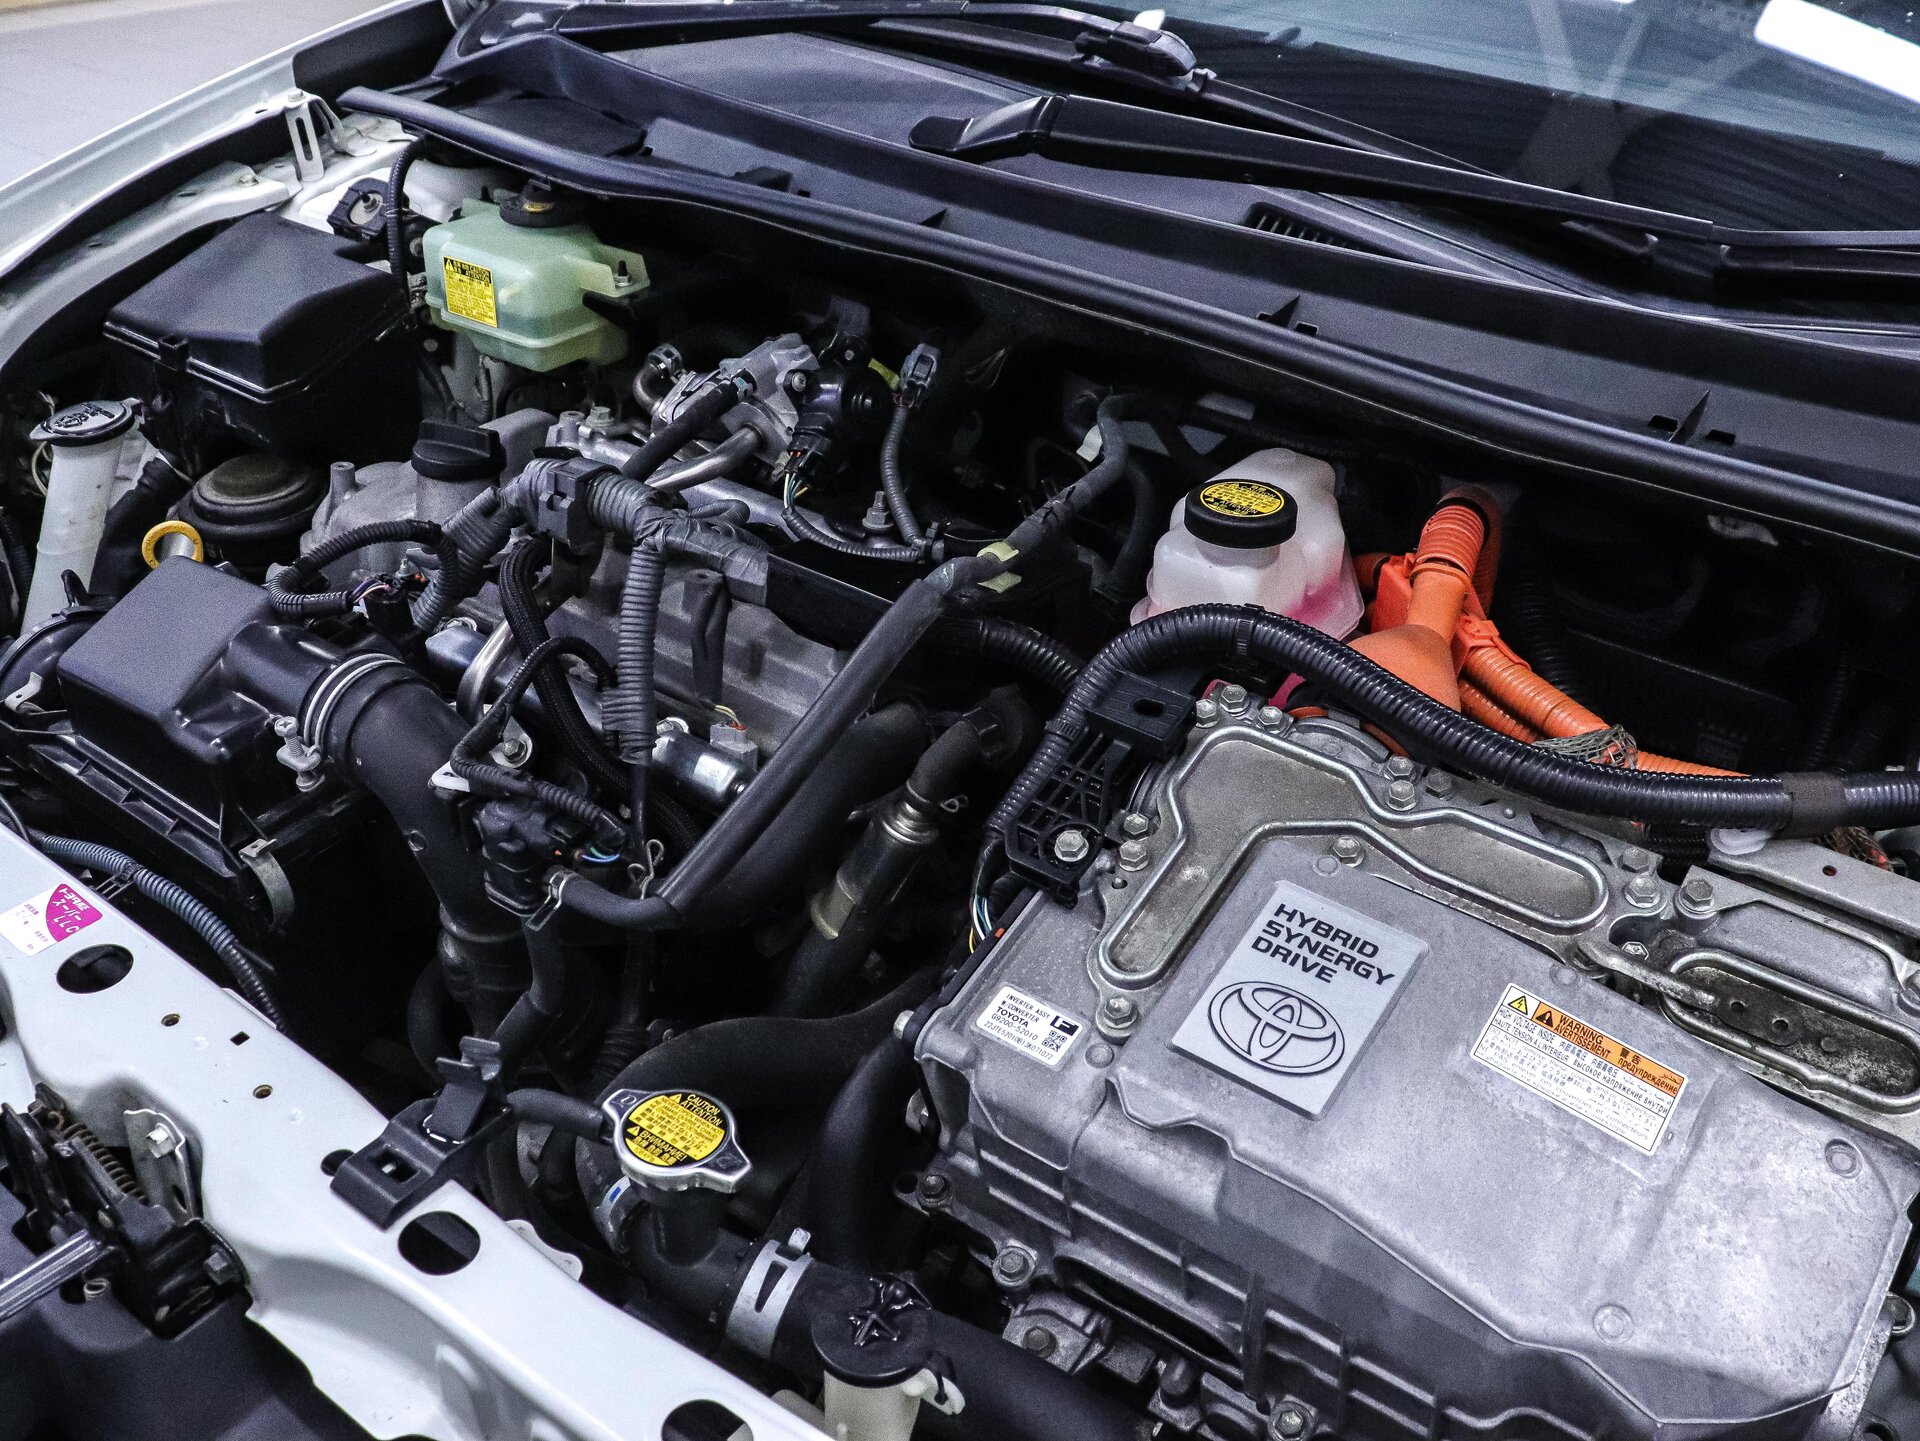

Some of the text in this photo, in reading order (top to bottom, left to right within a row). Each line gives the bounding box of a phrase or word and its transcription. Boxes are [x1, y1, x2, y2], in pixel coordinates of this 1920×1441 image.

[53, 915, 80, 933] LLC
[1274, 903, 1379, 958] HYBRID
[1251, 936, 1338, 983] DRIVE
[1262, 920, 1395, 985] SYNERGY
[995, 1006, 1030, 1027] TOYOTA
[1005, 993, 1050, 1019] INVERTER ASSY
[990, 1012, 1038, 1041] G9200-52010
[1492, 1016, 1511, 1031] HAUTE
[1510, 1026, 1534, 1043] TENSION
[1497, 1006, 1556, 1043] HIGH VOLTAGE INSIDE
[1558, 1014, 1604, 1045] WARNING
[1553, 1023, 1611, 1059] AVERTISSEMENT
[1572, 1058, 1602, 1079] высокое
[1600, 1074, 1643, 1102] напряжение
[1642, 1096, 1668, 1116] внутри
[1616, 1056, 1678, 1096] предупреждение
[679, 1099, 722, 1126] ATTENTION
[685, 1093, 721, 1115] CAUTION
[677, 1107, 694, 1118] OPEN
[693, 1116, 711, 1128] WHEN
[709, 1126, 723, 1135] HOT
[637, 1130, 688, 1161] ВНИМАНИЕ!
